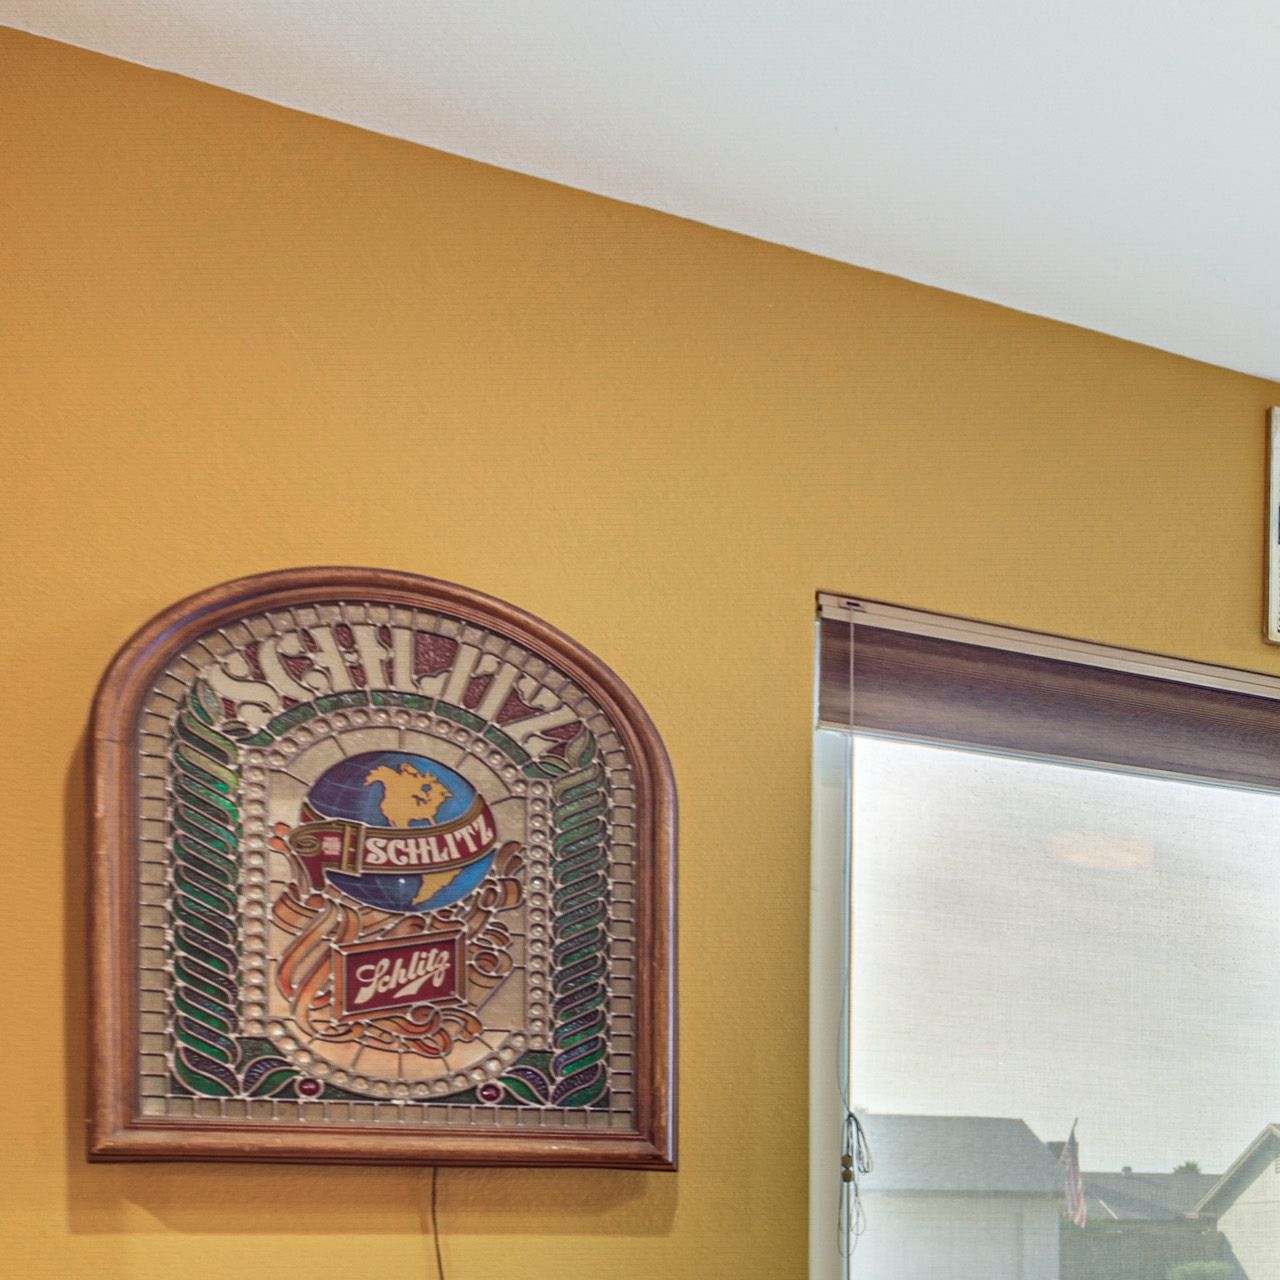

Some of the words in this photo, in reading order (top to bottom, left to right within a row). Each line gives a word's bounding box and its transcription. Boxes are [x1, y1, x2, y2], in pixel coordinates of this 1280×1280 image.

[206, 624, 578, 757] SCHLITZ
[365, 814, 494, 866] SCHLITZ
[354, 948, 452, 1004] Schlitz
